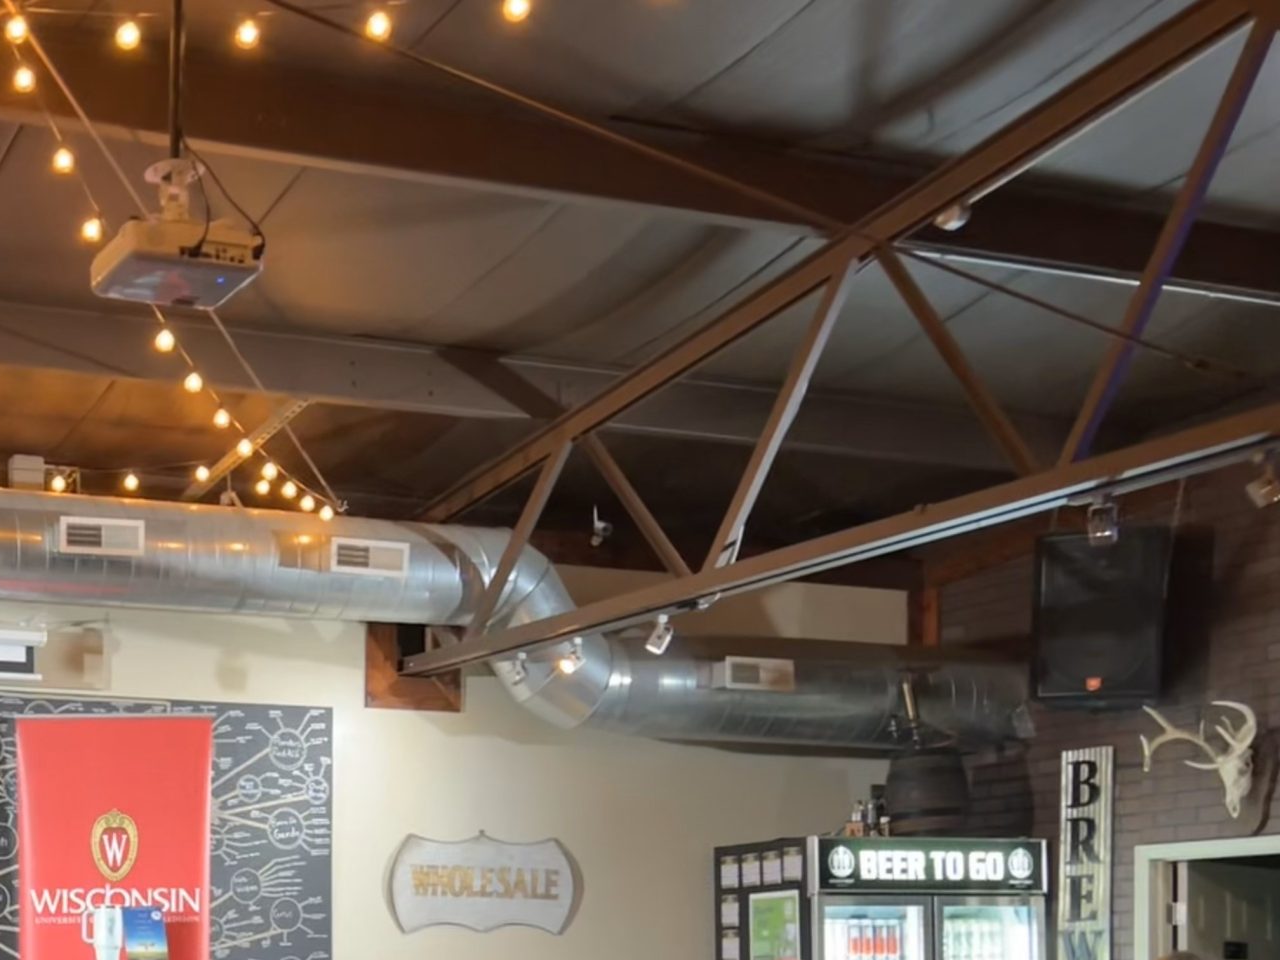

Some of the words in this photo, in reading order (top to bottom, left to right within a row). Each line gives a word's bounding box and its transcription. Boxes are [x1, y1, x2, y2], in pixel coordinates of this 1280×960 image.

[102, 833, 128, 867] W
[859, 850, 926, 880] BEER
[930, 851, 965, 880] TO
[969, 851, 1005, 880] GO
[410, 864, 560, 900] WHOLESALE
[30, 886, 201, 915] WISCONSIN
